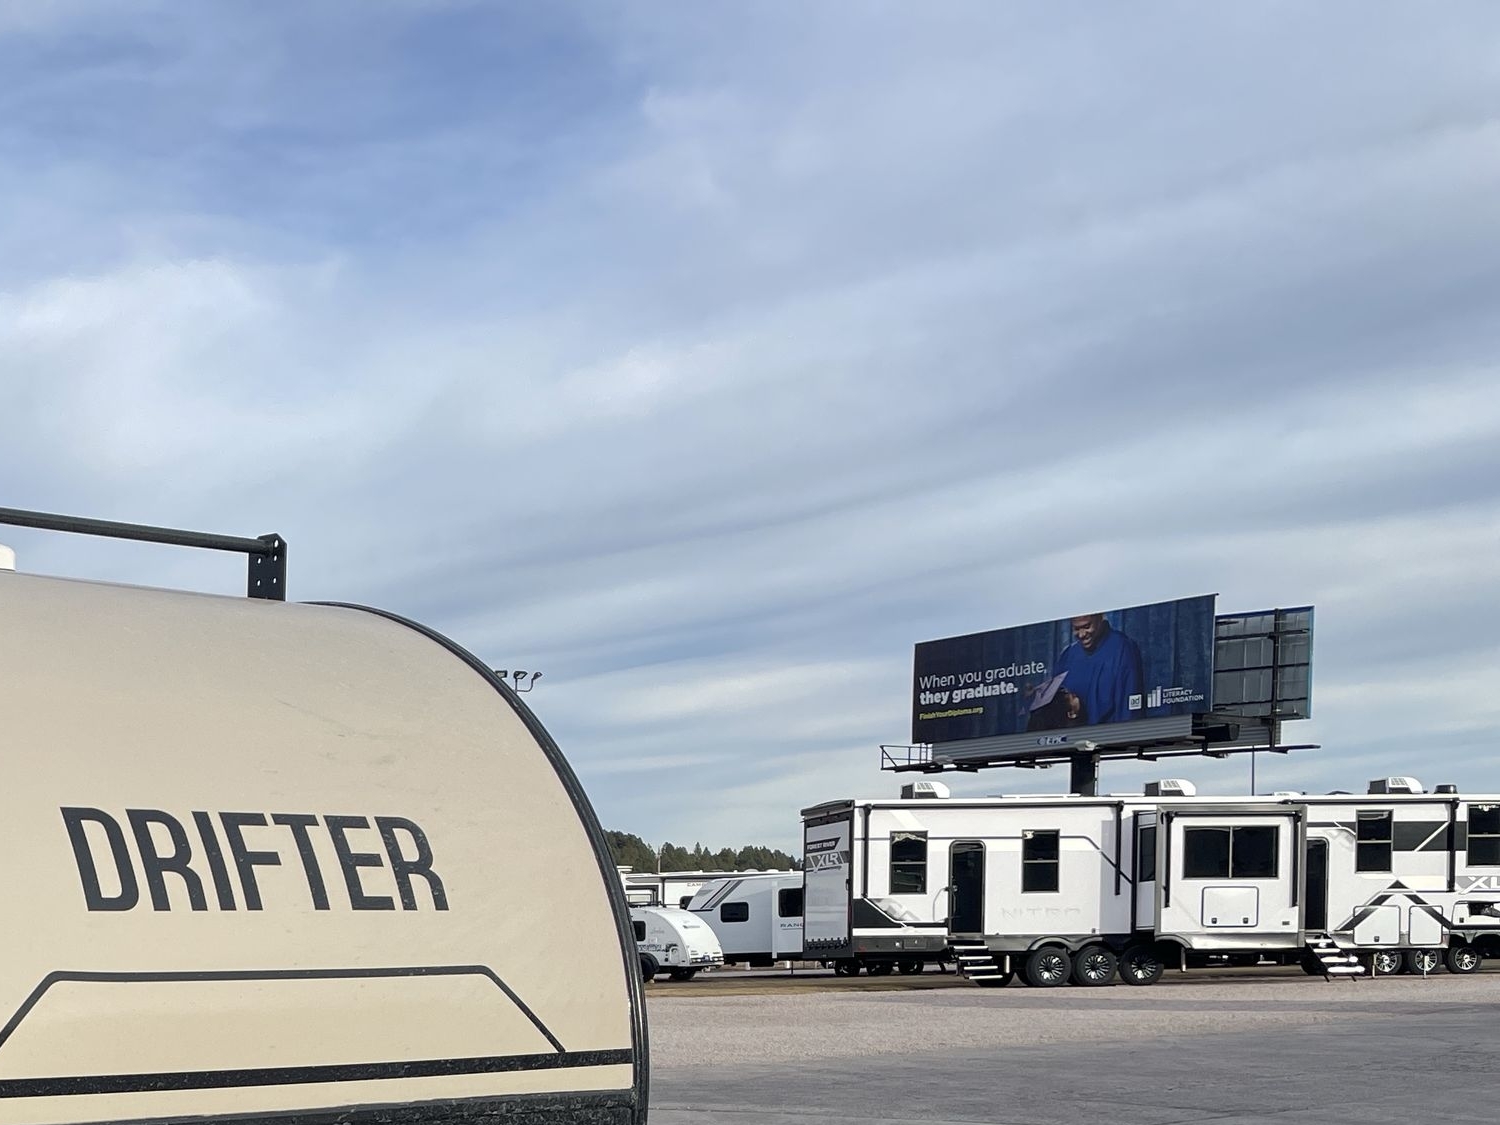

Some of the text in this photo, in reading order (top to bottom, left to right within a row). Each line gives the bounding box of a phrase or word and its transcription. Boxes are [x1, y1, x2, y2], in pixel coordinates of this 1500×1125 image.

[919, 661, 1048, 689] When you graduate,
[919, 681, 1019, 705] they graduate.
[1162, 689, 1193, 698] LITERACY
[1162, 694, 1204, 704] FOUNDATION
[60, 806, 450, 912] DRIFTER
